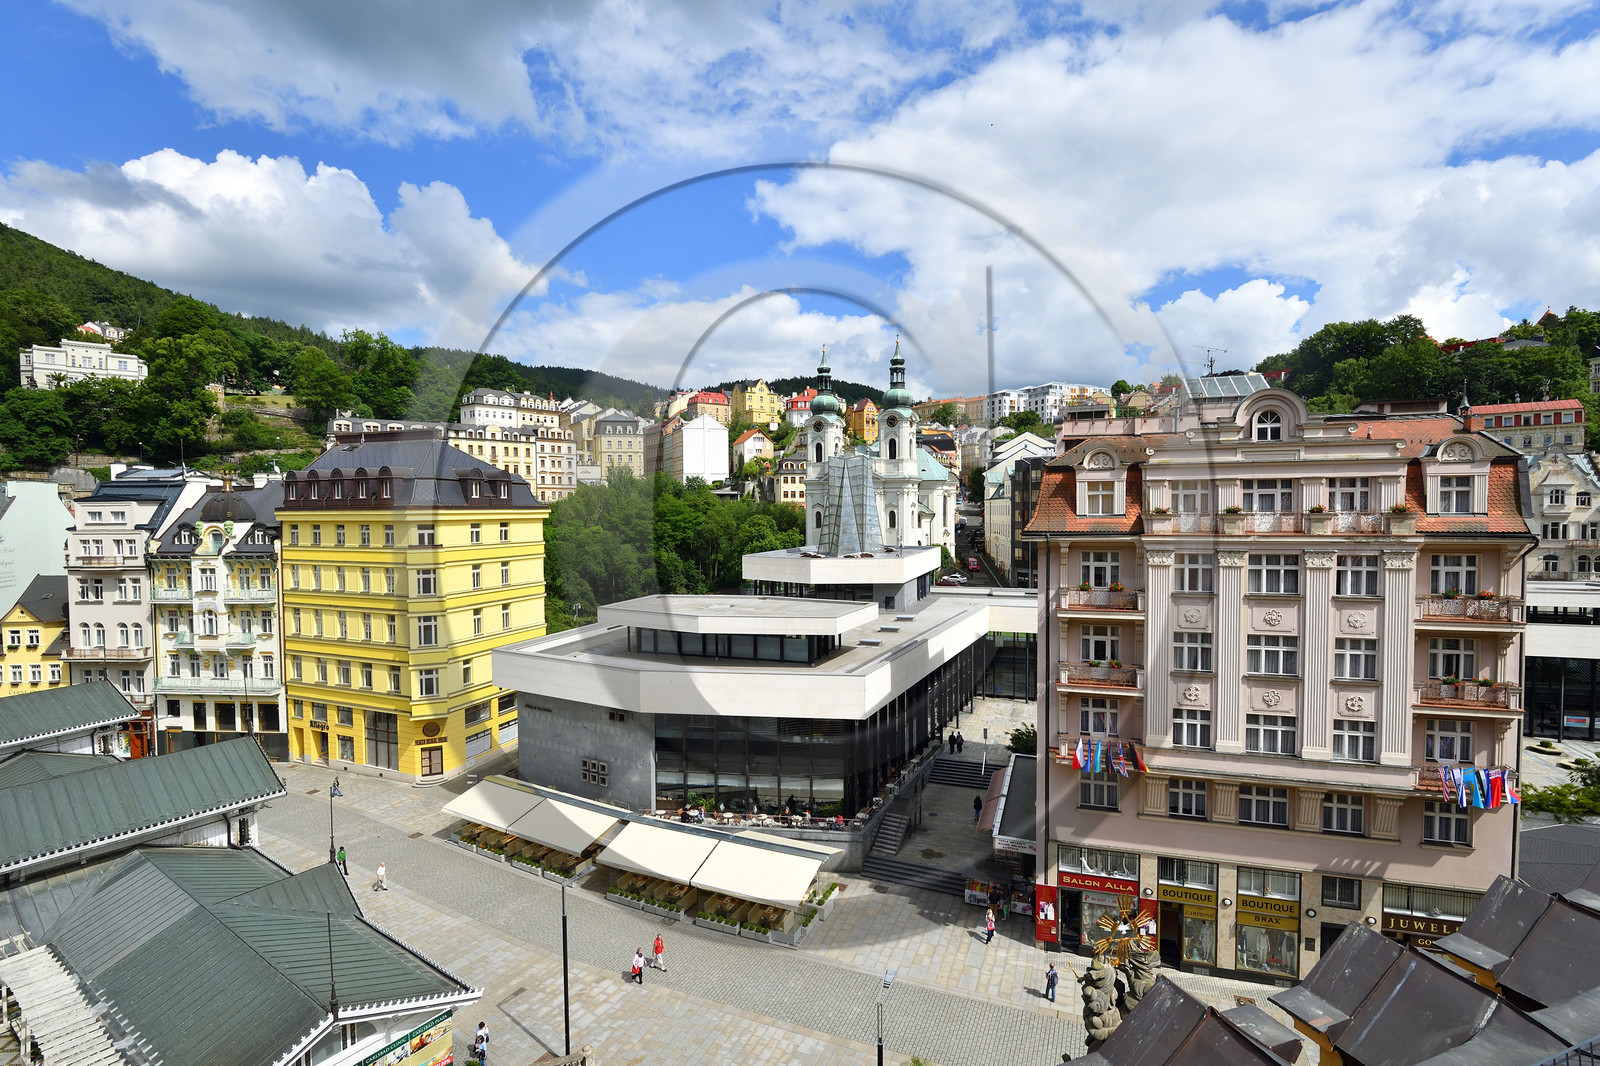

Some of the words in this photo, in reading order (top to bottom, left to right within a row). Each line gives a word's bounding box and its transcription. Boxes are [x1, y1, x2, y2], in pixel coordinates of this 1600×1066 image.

[310, 720, 330, 731] Allegro
[1062, 875, 1100, 887] SALON
[1104, 881, 1134, 892] ALLA
[1162, 888, 1213, 903] BOUTIQUE
[1241, 899, 1295, 914] BOUTIQUE
[1254, 915, 1281, 925] BRAX
[1417, 938, 1434, 946] GO
[390, 1036, 407, 1050] CLINIC
